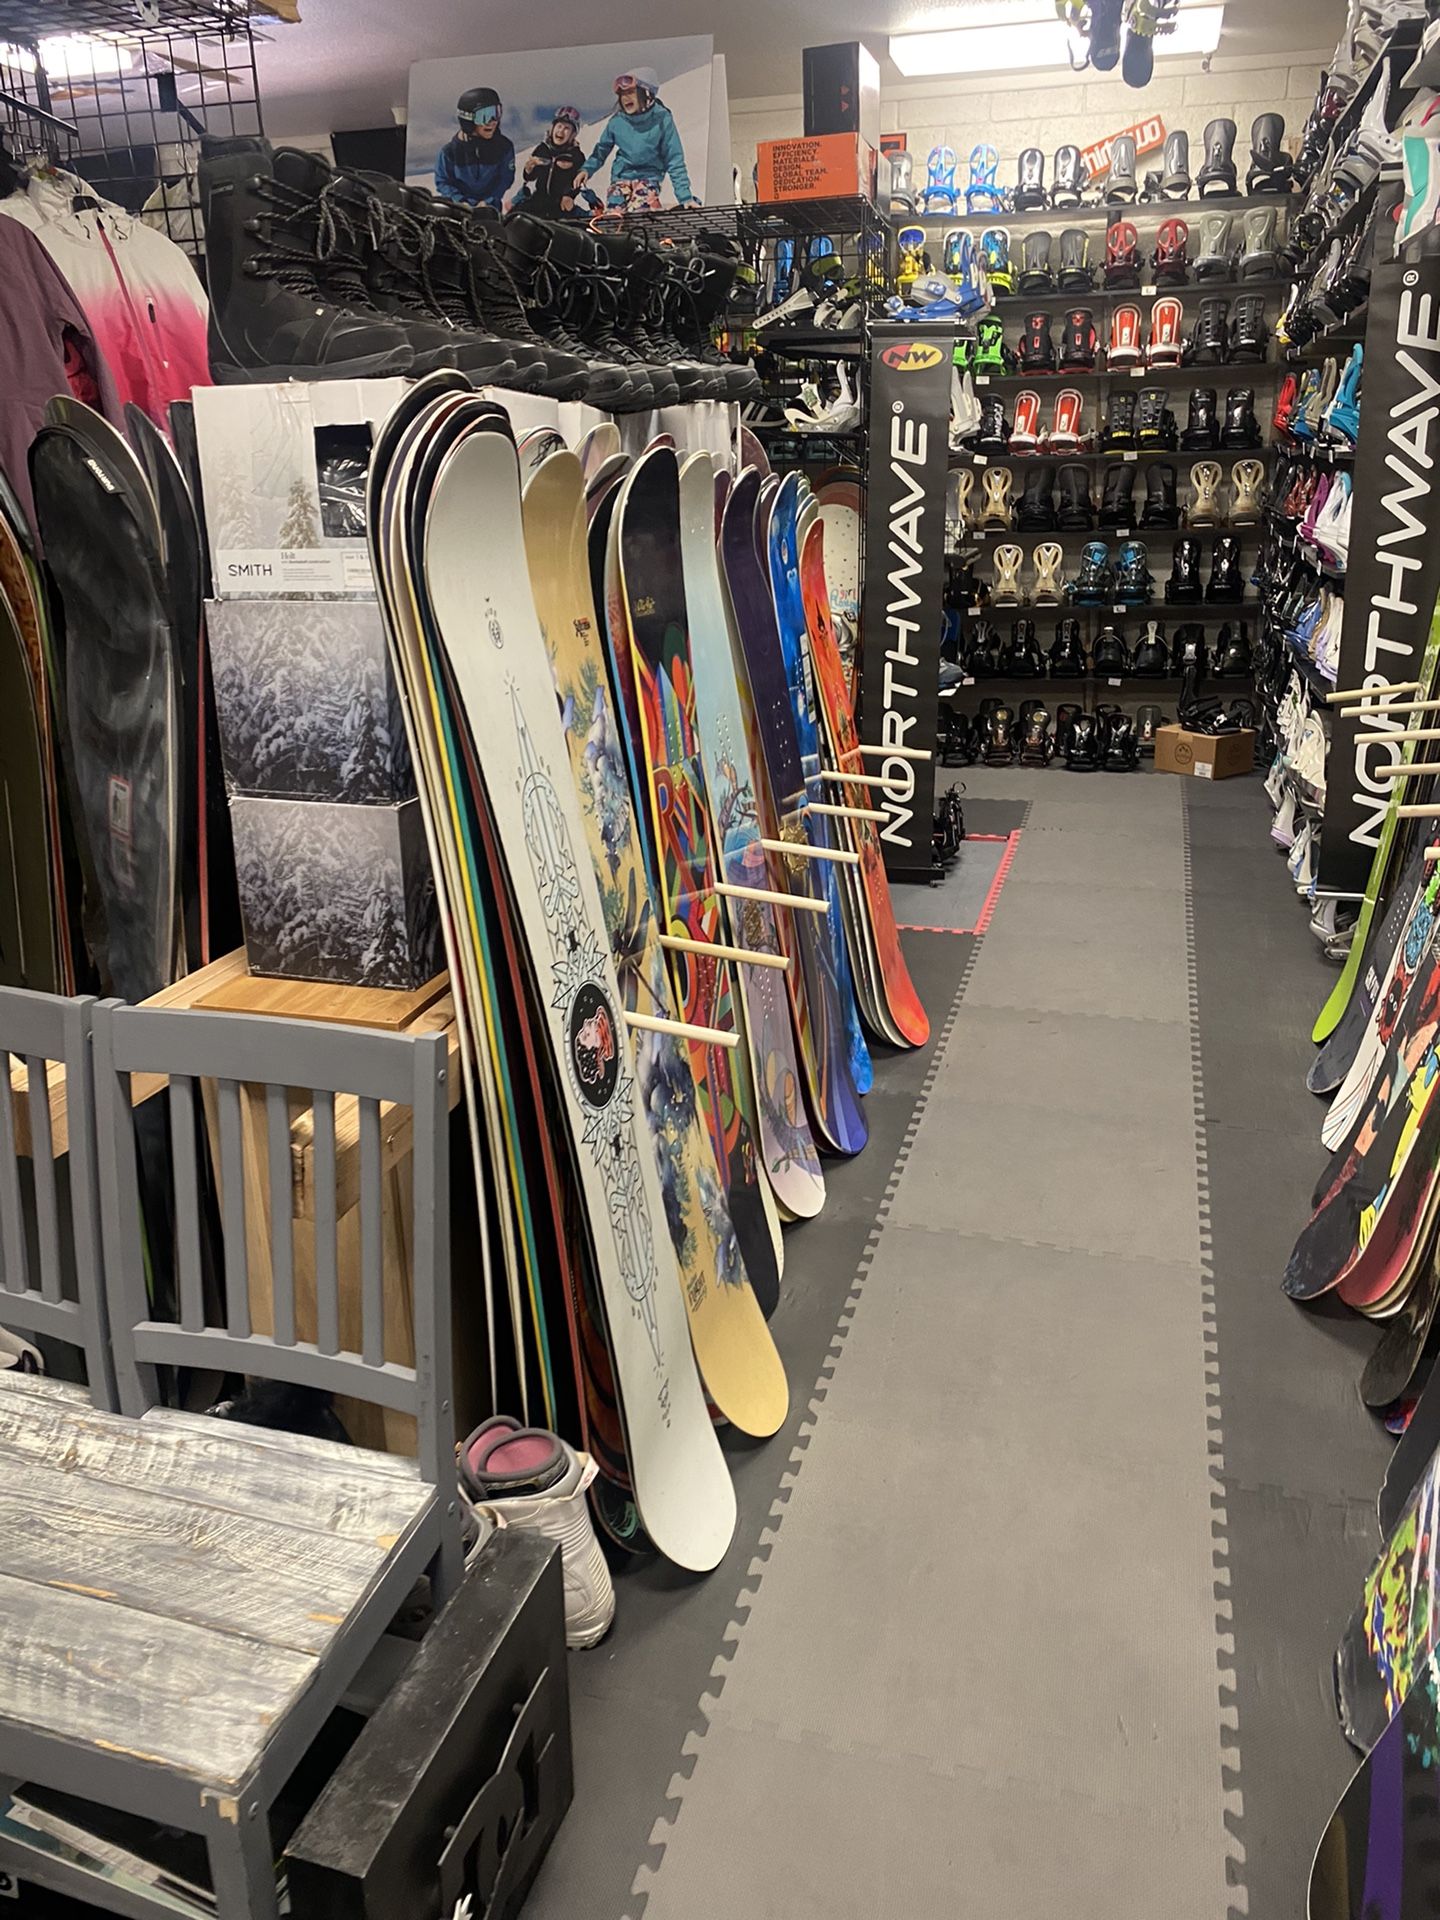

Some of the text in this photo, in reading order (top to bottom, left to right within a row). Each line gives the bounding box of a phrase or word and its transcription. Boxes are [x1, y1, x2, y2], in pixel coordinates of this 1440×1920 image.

[773, 170, 803, 178] GLOBAL
[888, 350, 937, 364] NW
[228, 564, 273, 577] SMITH
